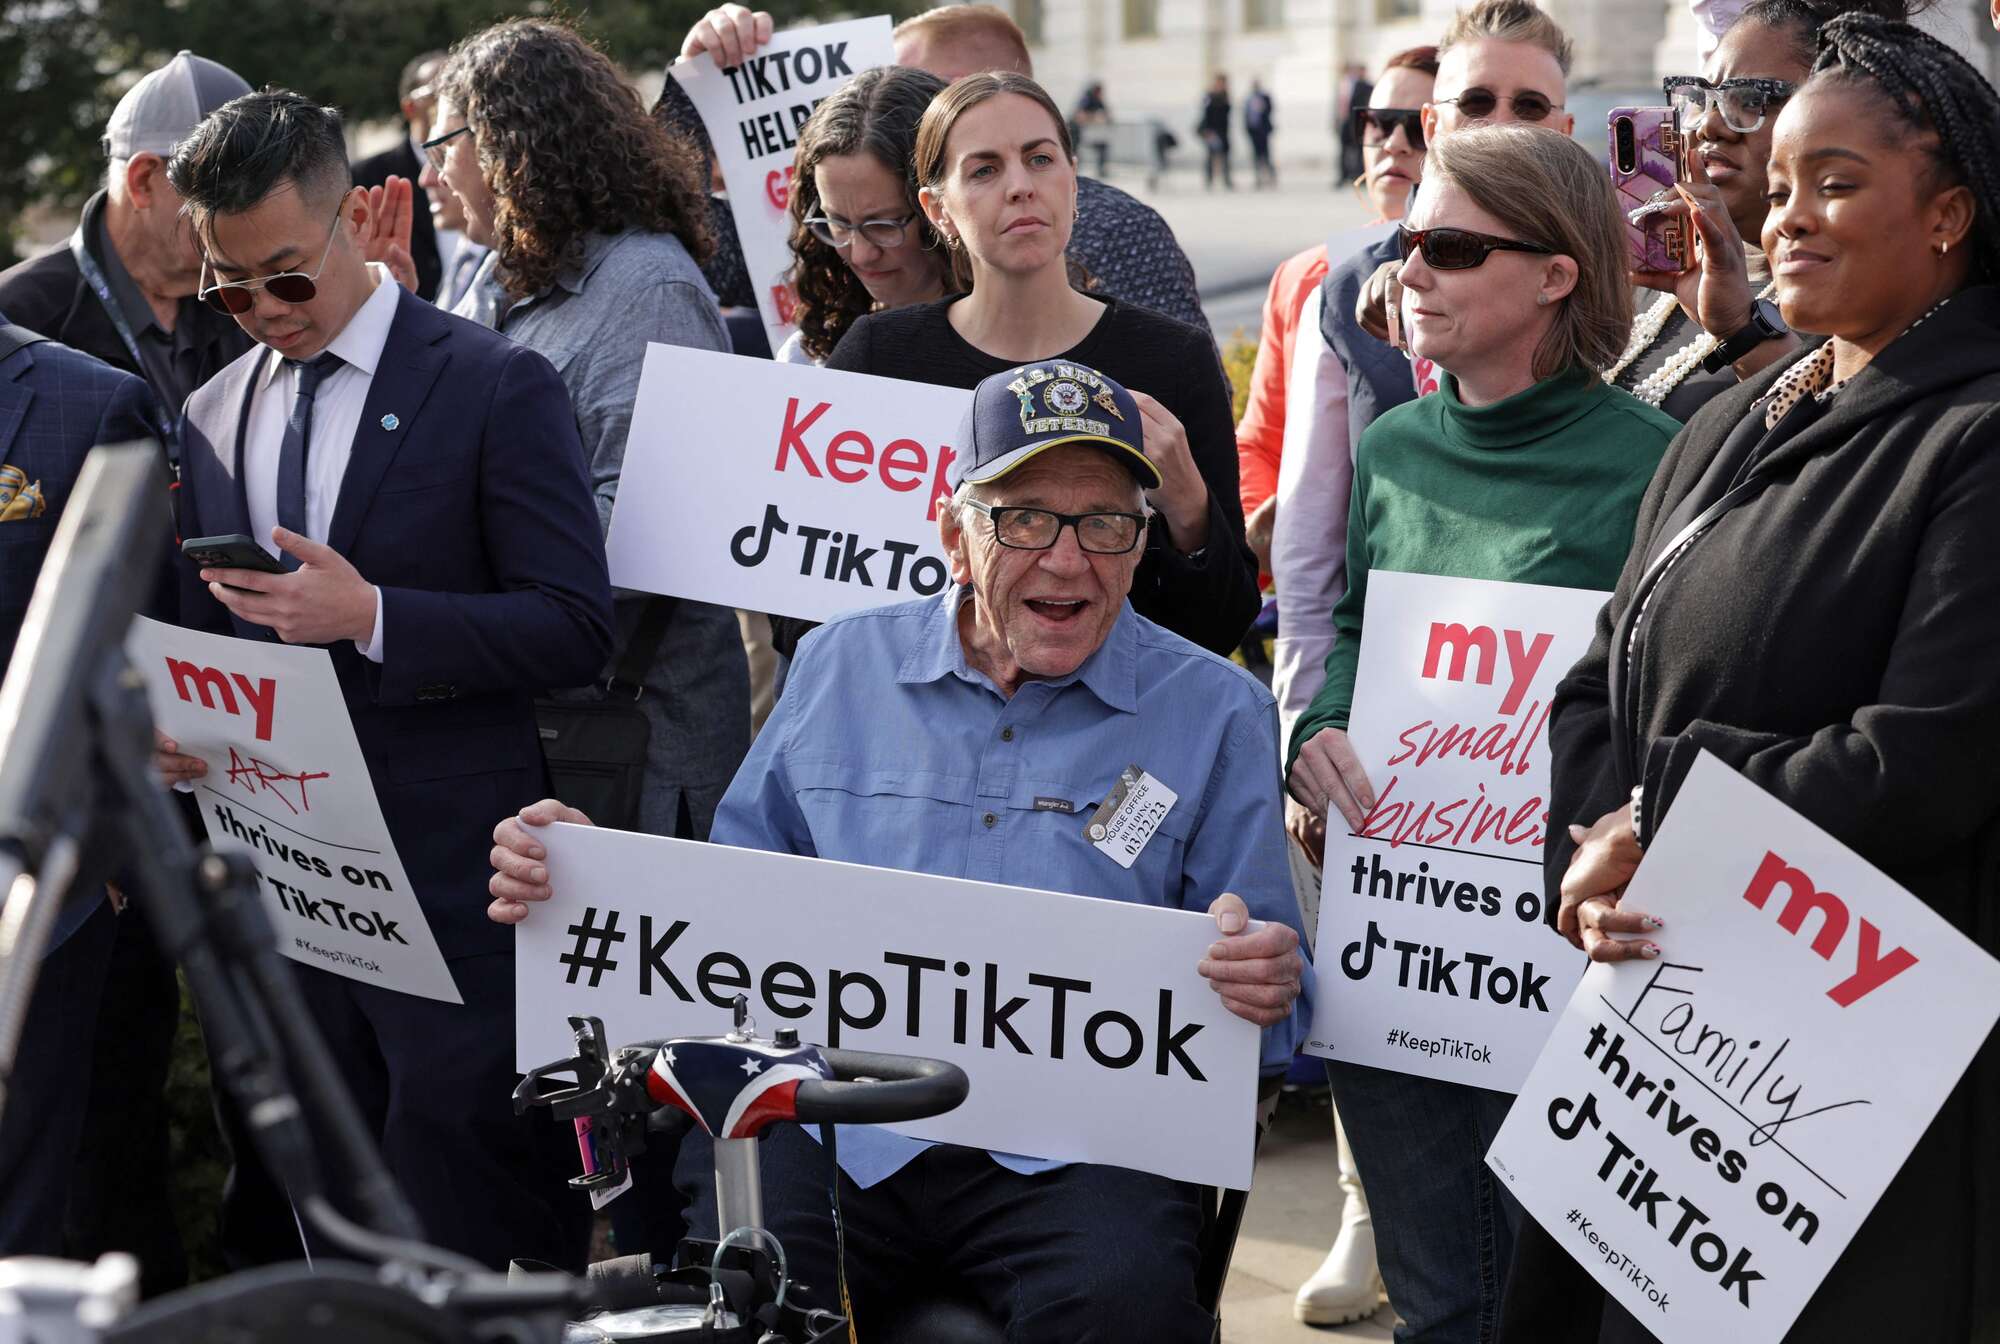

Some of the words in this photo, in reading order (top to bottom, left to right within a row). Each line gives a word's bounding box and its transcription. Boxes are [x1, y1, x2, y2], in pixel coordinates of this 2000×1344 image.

[722, 41, 853, 104] TIKTOK
[1007, 368, 1054, 394] U.S.
[1053, 364, 1113, 396] NAVY
[1025, 416, 1110, 435] VETERAN
[797, 525, 955, 596] TikTo
[165, 656, 276, 741] my
[1421, 622, 1554, 716] my
[1387, 699, 1553, 775] small
[225, 746, 330, 815] ART
[1106, 814, 1128, 844] HOUSE
[1125, 785, 1149, 815] OFFICE
[215, 804, 332, 878] thrives
[341, 864, 393, 891] on
[1125, 802, 1166, 855] 03/22/23
[267, 877, 410, 945] TikTok
[1351, 854, 1501, 916] thrives
[295, 937, 383, 974] #KeepTikTok
[1742, 850, 1920, 1008] my
[559, 907, 1208, 1082] #KeepTikTok
[1393, 940, 1551, 1012] TikTok
[1387, 1029, 1491, 1063] #KeepTikTok
[1626, 961, 1872, 1146] Family
[1584, 1022, 1747, 1183] thrives
[1756, 1182, 1820, 1246] on
[1597, 1132, 1766, 1309] TikTok
[1566, 1208, 1672, 1313] #KeepTikTok
